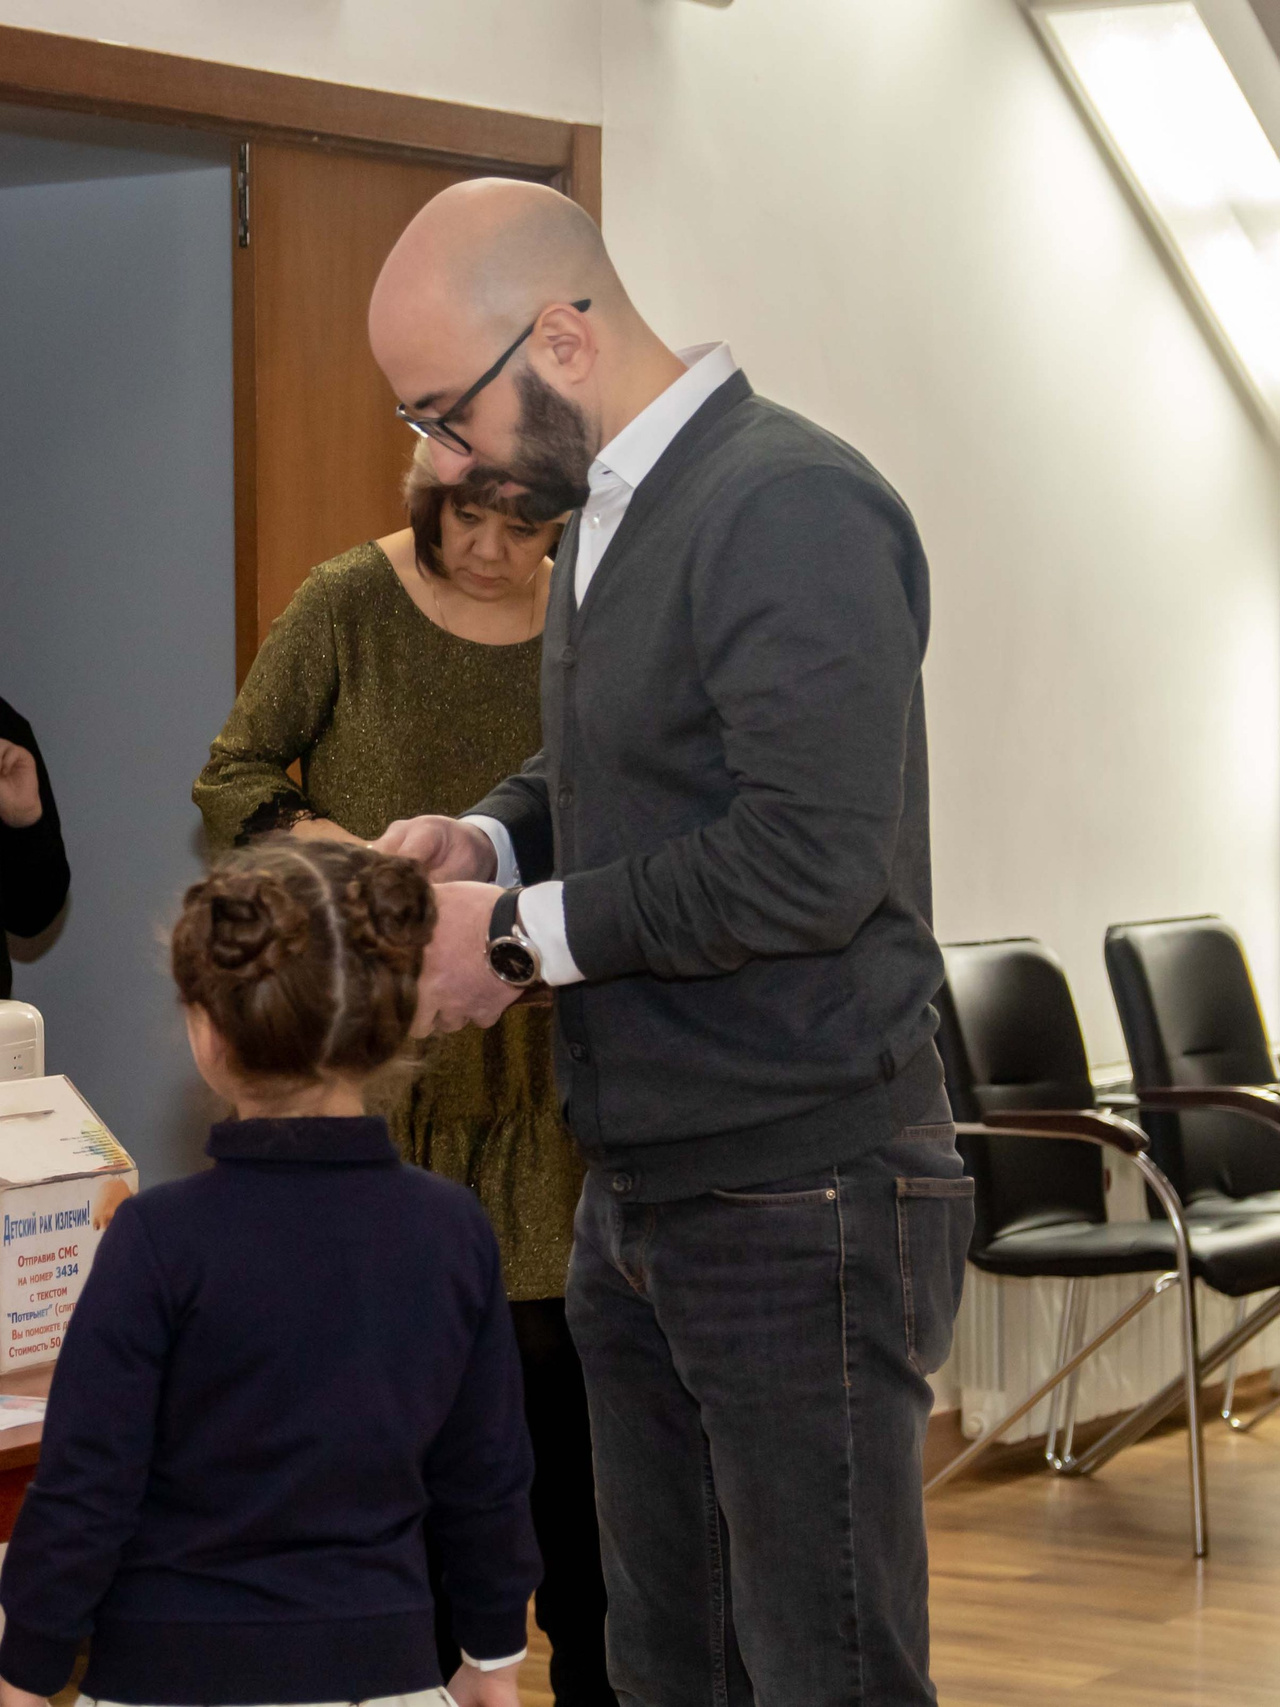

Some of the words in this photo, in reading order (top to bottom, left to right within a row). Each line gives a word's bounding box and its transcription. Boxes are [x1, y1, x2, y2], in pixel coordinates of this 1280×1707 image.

[58, 1245, 79, 1260] СМС
[56, 1263, 79, 1279] 3434
[50, 1336, 61, 1349] 50
